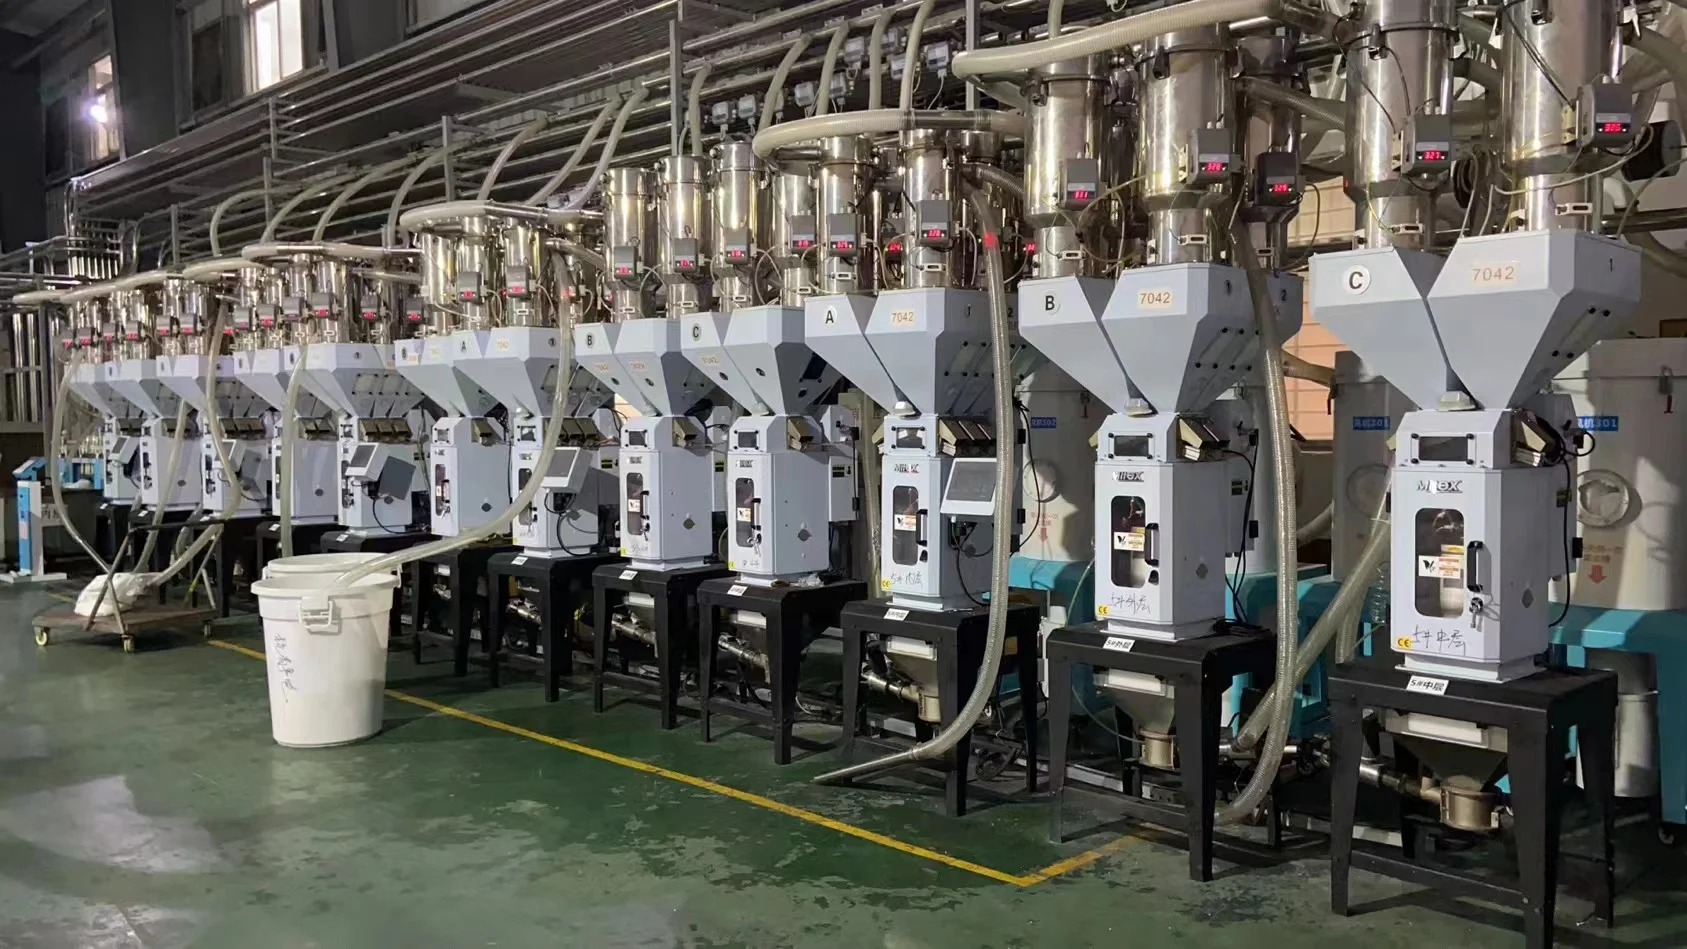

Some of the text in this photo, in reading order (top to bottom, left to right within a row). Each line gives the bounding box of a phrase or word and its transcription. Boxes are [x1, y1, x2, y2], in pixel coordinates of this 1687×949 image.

[1472, 266, 1515, 281] 7042
[1348, 271, 1364, 290] C
[1045, 295, 1055, 311] B
[1139, 291, 1171, 305] 7042
[825, 310, 835, 324] A
[892, 312, 914, 323] 7042
[692, 326, 700, 339] C
[587, 334, 593, 346] B
[1397, 637, 1411, 648] CE
[1410, 679, 1445, 692] 5#中层
